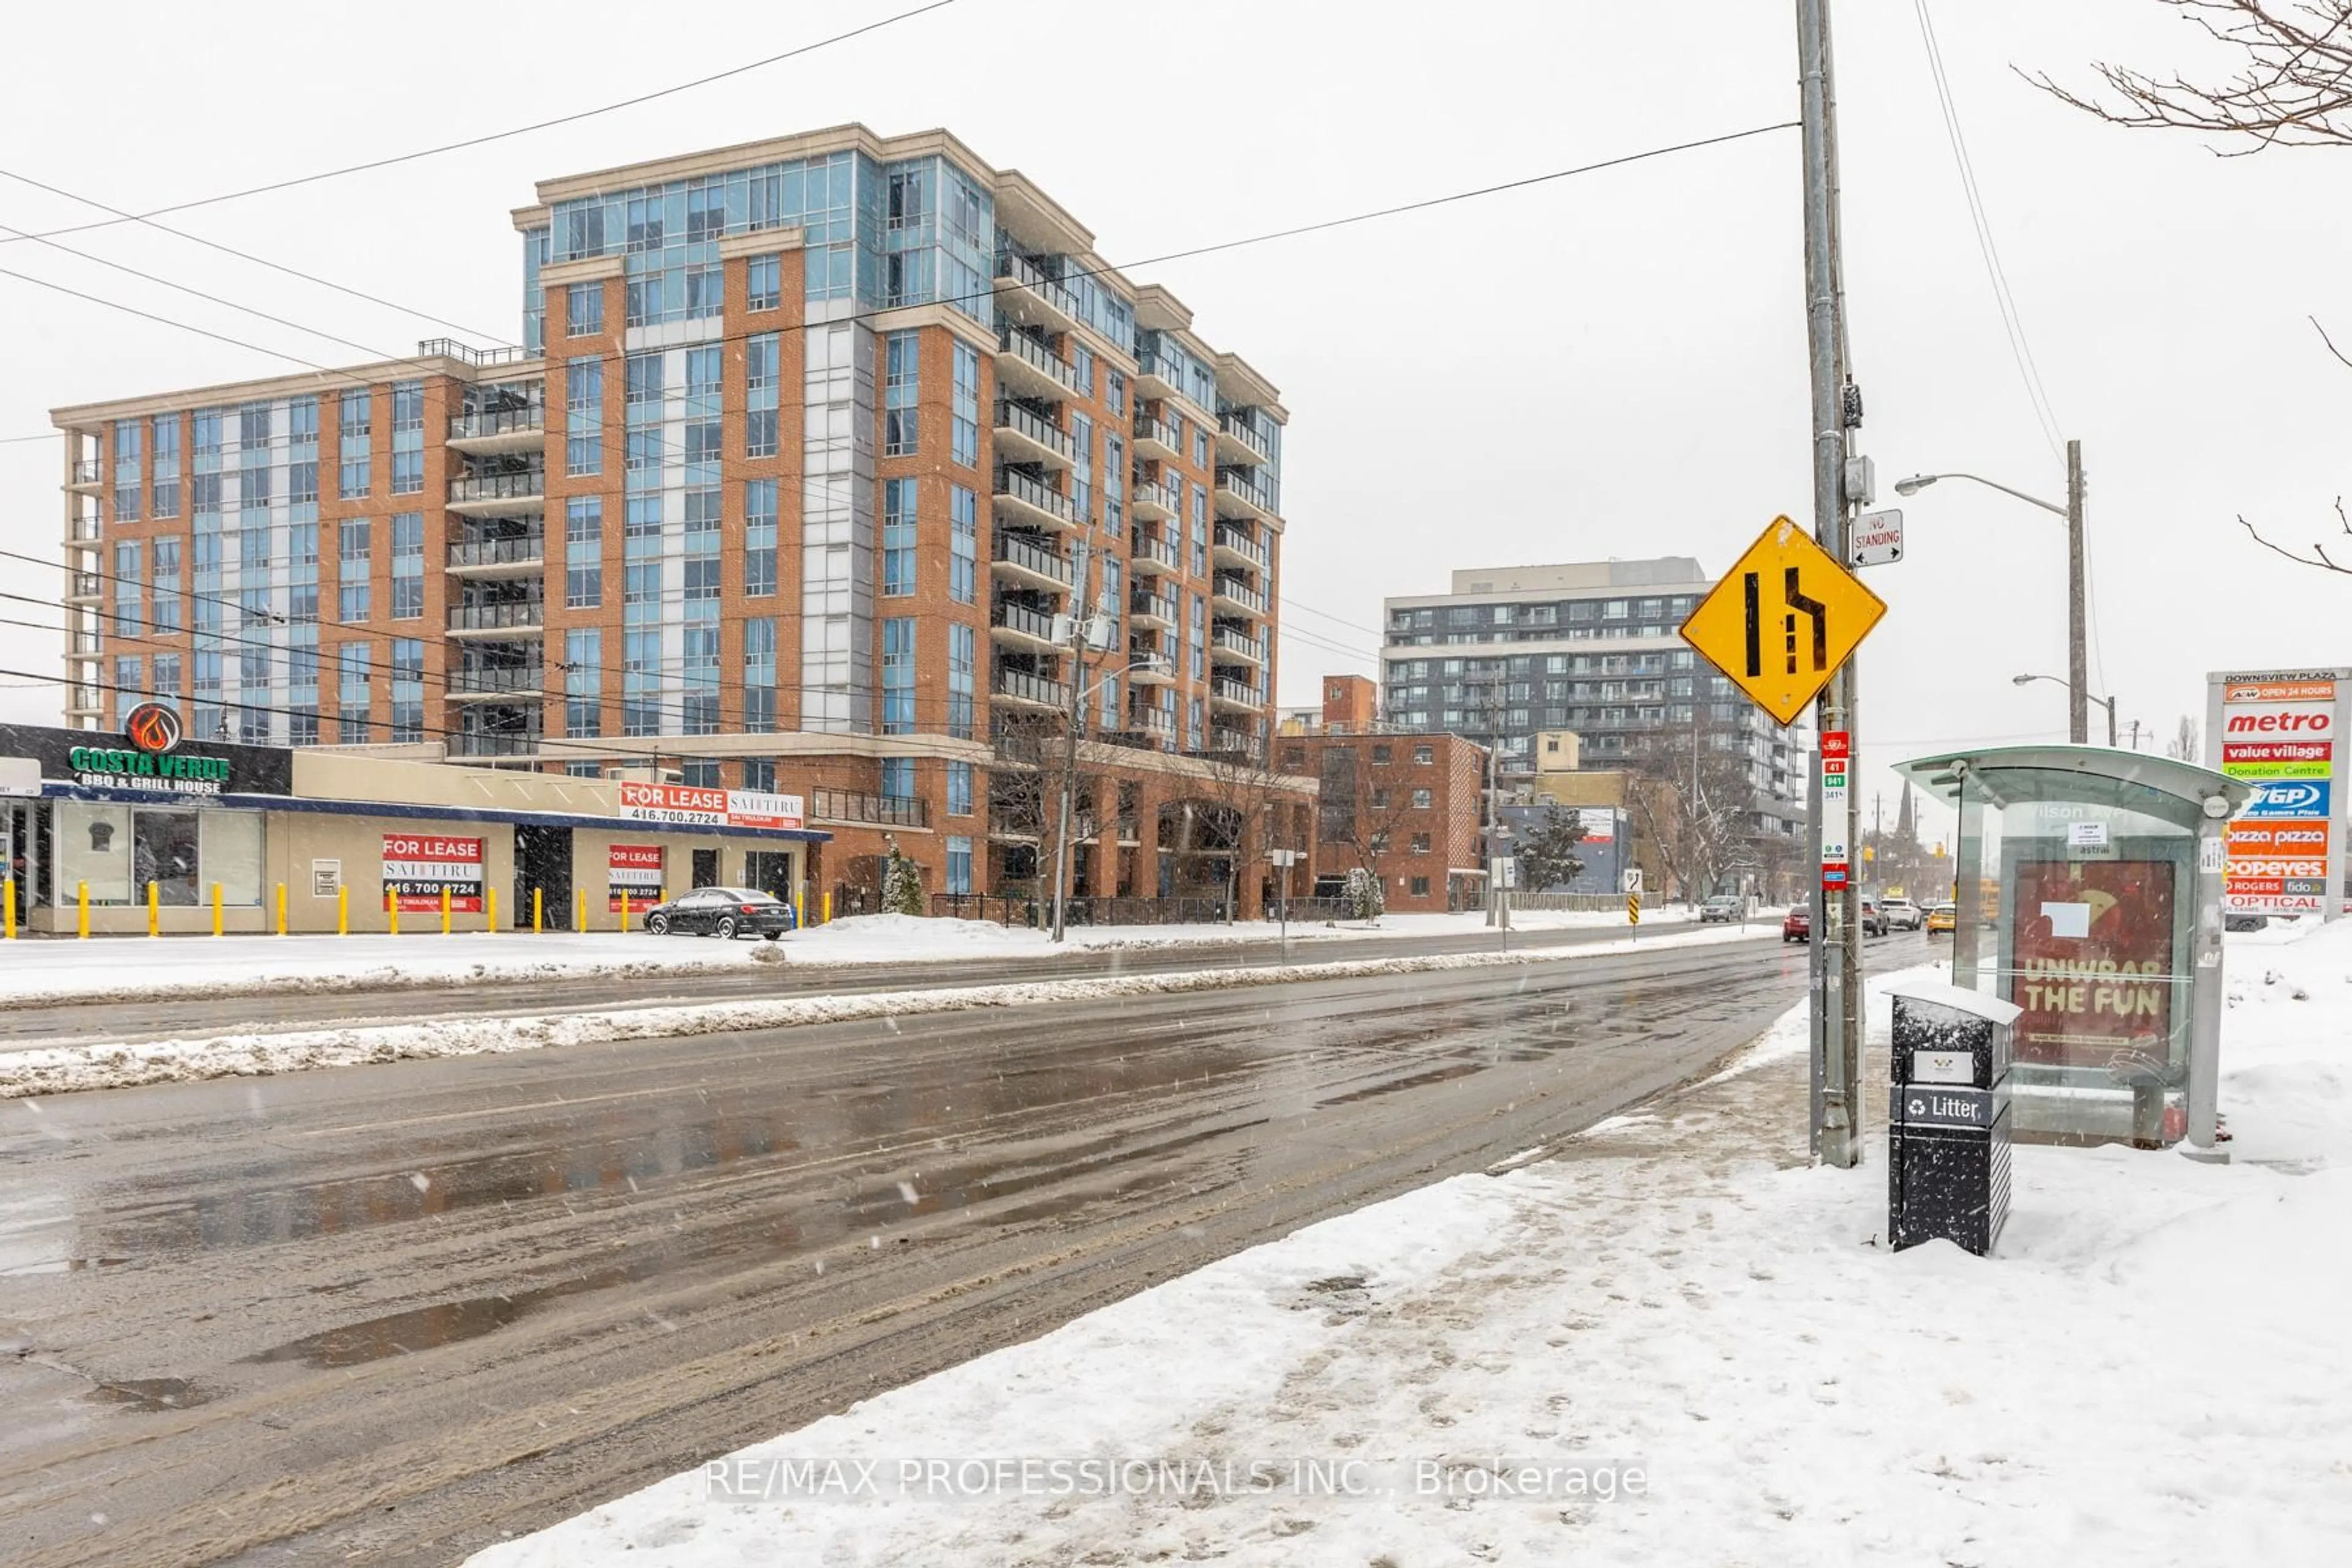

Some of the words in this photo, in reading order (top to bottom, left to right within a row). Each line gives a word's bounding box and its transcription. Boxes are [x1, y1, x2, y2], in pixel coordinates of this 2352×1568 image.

[1869, 516, 1884, 529] NO
[1855, 530, 1899, 549] STANDING
[2261, 688, 2286, 696] OPEN
[2288, 687, 2298, 696] 24
[2301, 685, 2332, 696] HOURS
[2228, 712, 2329, 732] metro
[2228, 746, 2270, 758] value
[2272, 744, 2324, 759] village
[71, 747, 153, 775] COSTA
[157, 755, 230, 781] VERDE
[1829, 763, 1840, 772] 41
[2228, 767, 2280, 776] Donation
[81, 773, 115, 788] BBQ
[116, 777, 129, 788] &
[131, 777, 172, 791] GRILL
[175, 780, 221, 794] HOUSE
[627, 786, 664, 805] FOR
[669, 789, 723, 810] LEASE
[730, 797, 754, 810] SAI
[632, 809, 719, 824] 416.700.2724
[2038, 803, 2082, 818] ilson
[2275, 831, 2324, 846] pizza
[383, 840, 419, 854] FOR
[424, 842, 478, 857] LEASE
[630, 853, 660, 862] LEASE
[386, 863, 416, 876] SAI
[429, 864, 473, 878] TIRU
[2234, 881, 2280, 891] ROGERS
[2287, 882, 2311, 892] fido
[2231, 896, 2322, 908] OPTICAL
[2024, 958, 2161, 984] UNWRAP
[2024, 985, 2086, 1013] THE
[2095, 987, 2161, 1016] FUN
[1932, 1096, 1979, 1118] Litter
